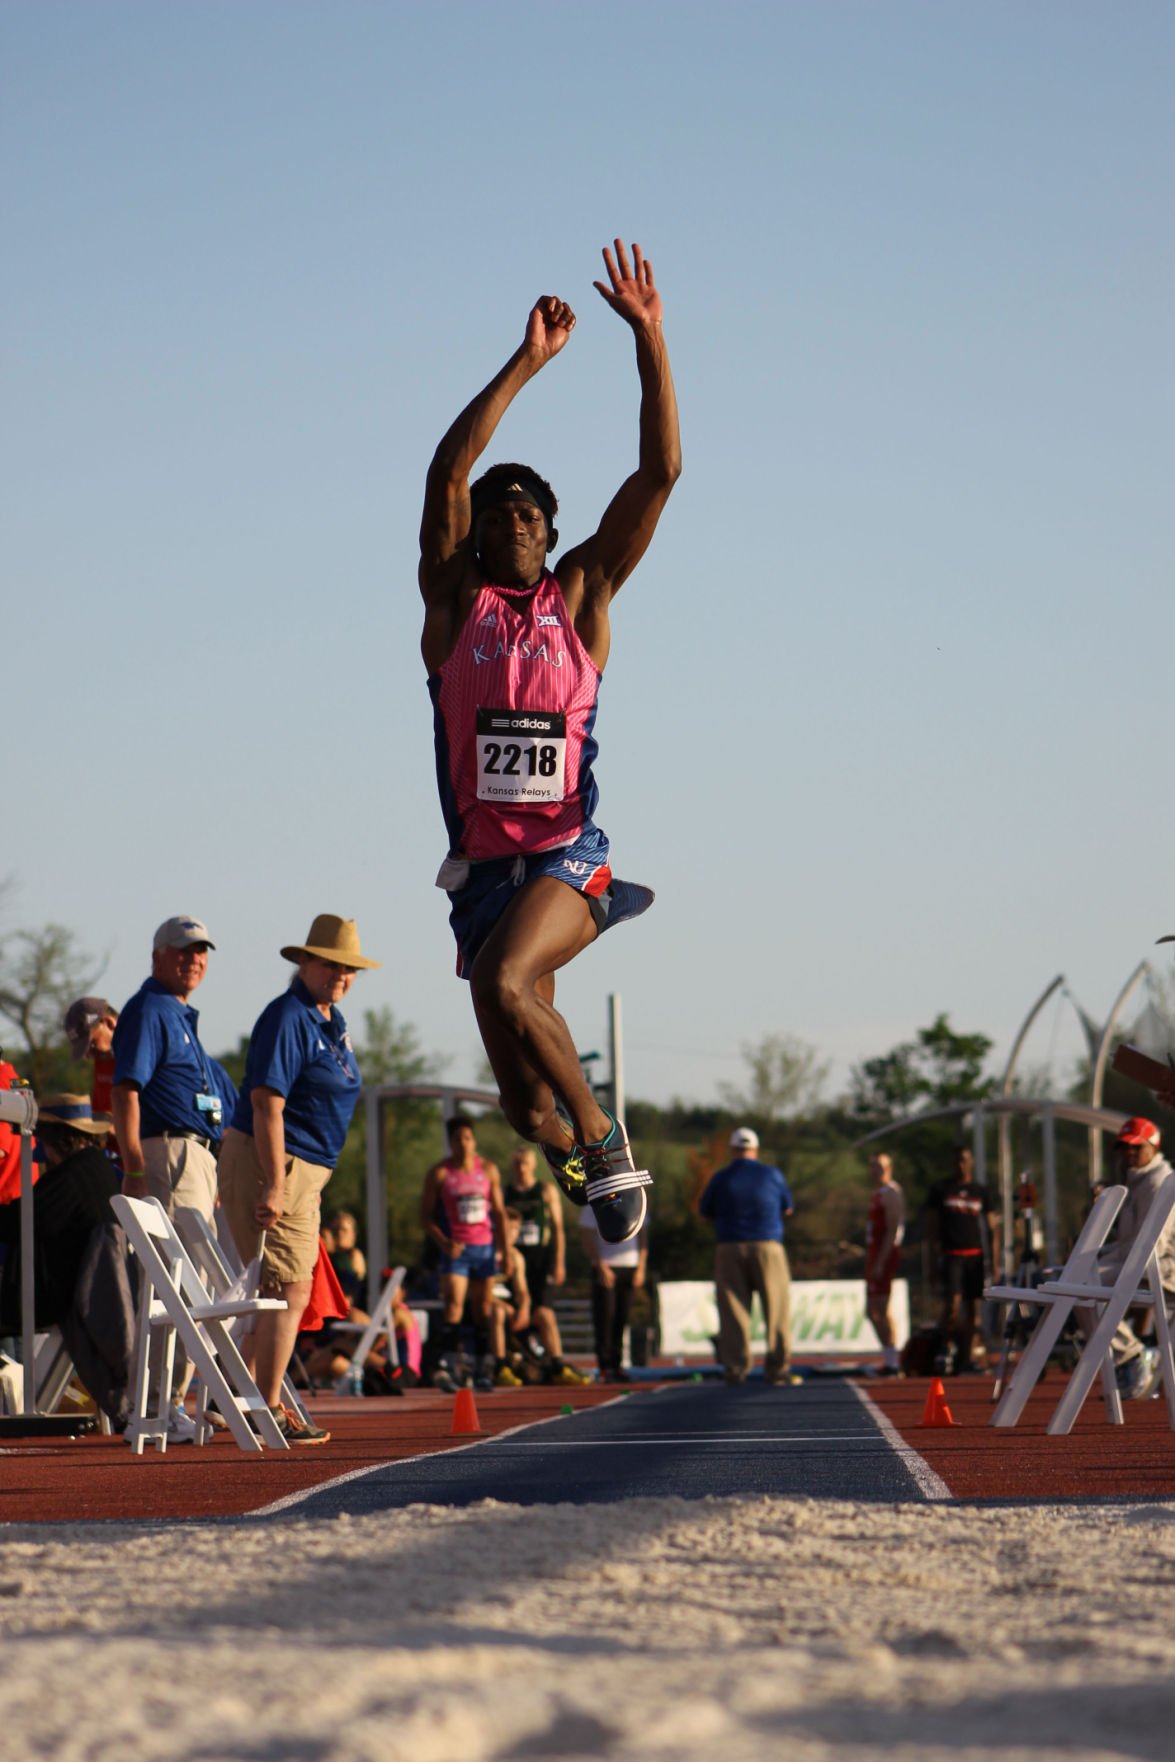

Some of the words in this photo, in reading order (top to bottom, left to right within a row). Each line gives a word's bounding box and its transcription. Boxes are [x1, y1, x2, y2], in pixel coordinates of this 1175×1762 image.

[511, 718, 551, 730] adidas
[483, 743, 557, 777] 2218
[487, 786, 519, 796] Kansas
[521, 788, 551, 797] Relays
